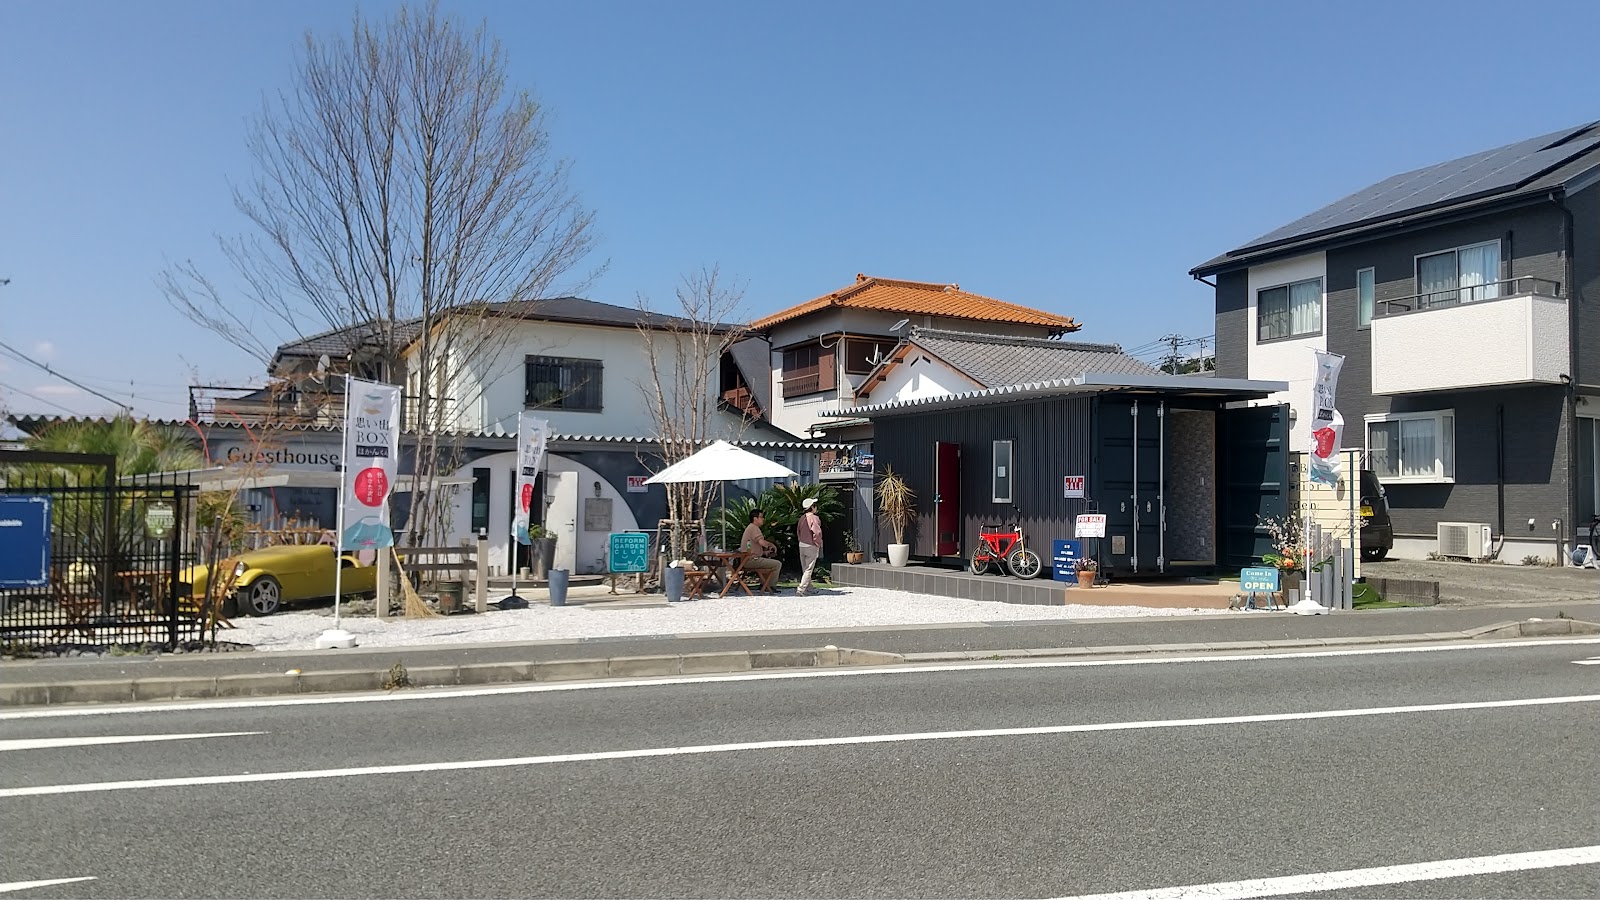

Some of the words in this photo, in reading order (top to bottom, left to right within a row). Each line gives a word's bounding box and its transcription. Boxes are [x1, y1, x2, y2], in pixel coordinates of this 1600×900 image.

[357, 431, 389, 444] BOX
[227, 446, 340, 466] Guesthouse
[1065, 482, 1083, 490] SALE
[1244, 582, 1274, 590] OPEN
